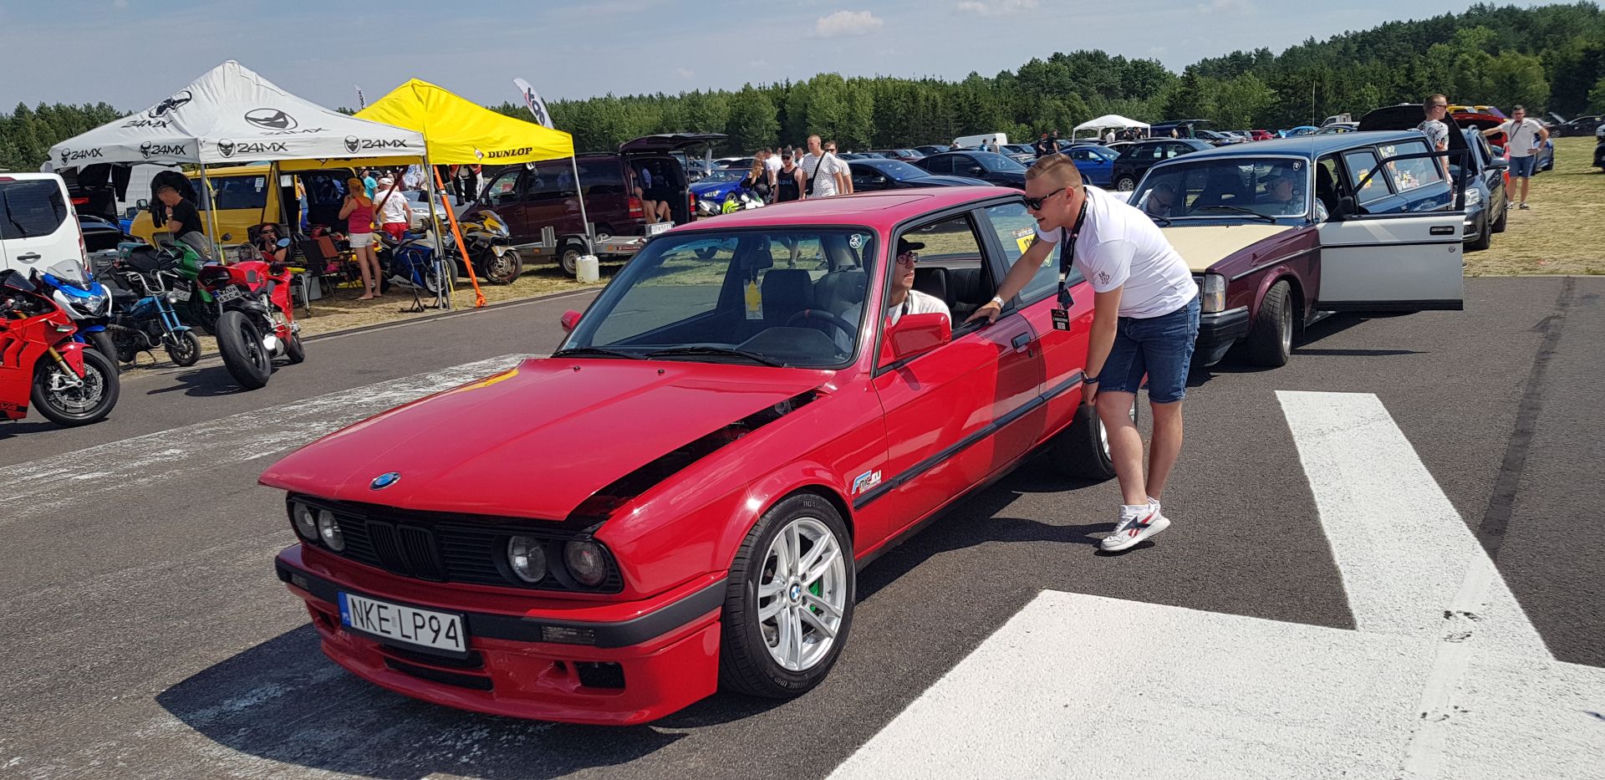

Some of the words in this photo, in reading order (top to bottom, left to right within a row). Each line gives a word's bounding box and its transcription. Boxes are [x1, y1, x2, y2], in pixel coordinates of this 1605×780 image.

[237, 142, 288, 153] 24MX
[362, 138, 408, 149] 24MX
[71, 148, 103, 161] 24MX
[151, 144, 186, 156] 24MX
[488, 147, 533, 159] DUNLOP
[351, 598, 392, 635] NKE
[398, 609, 460, 648] LP94
